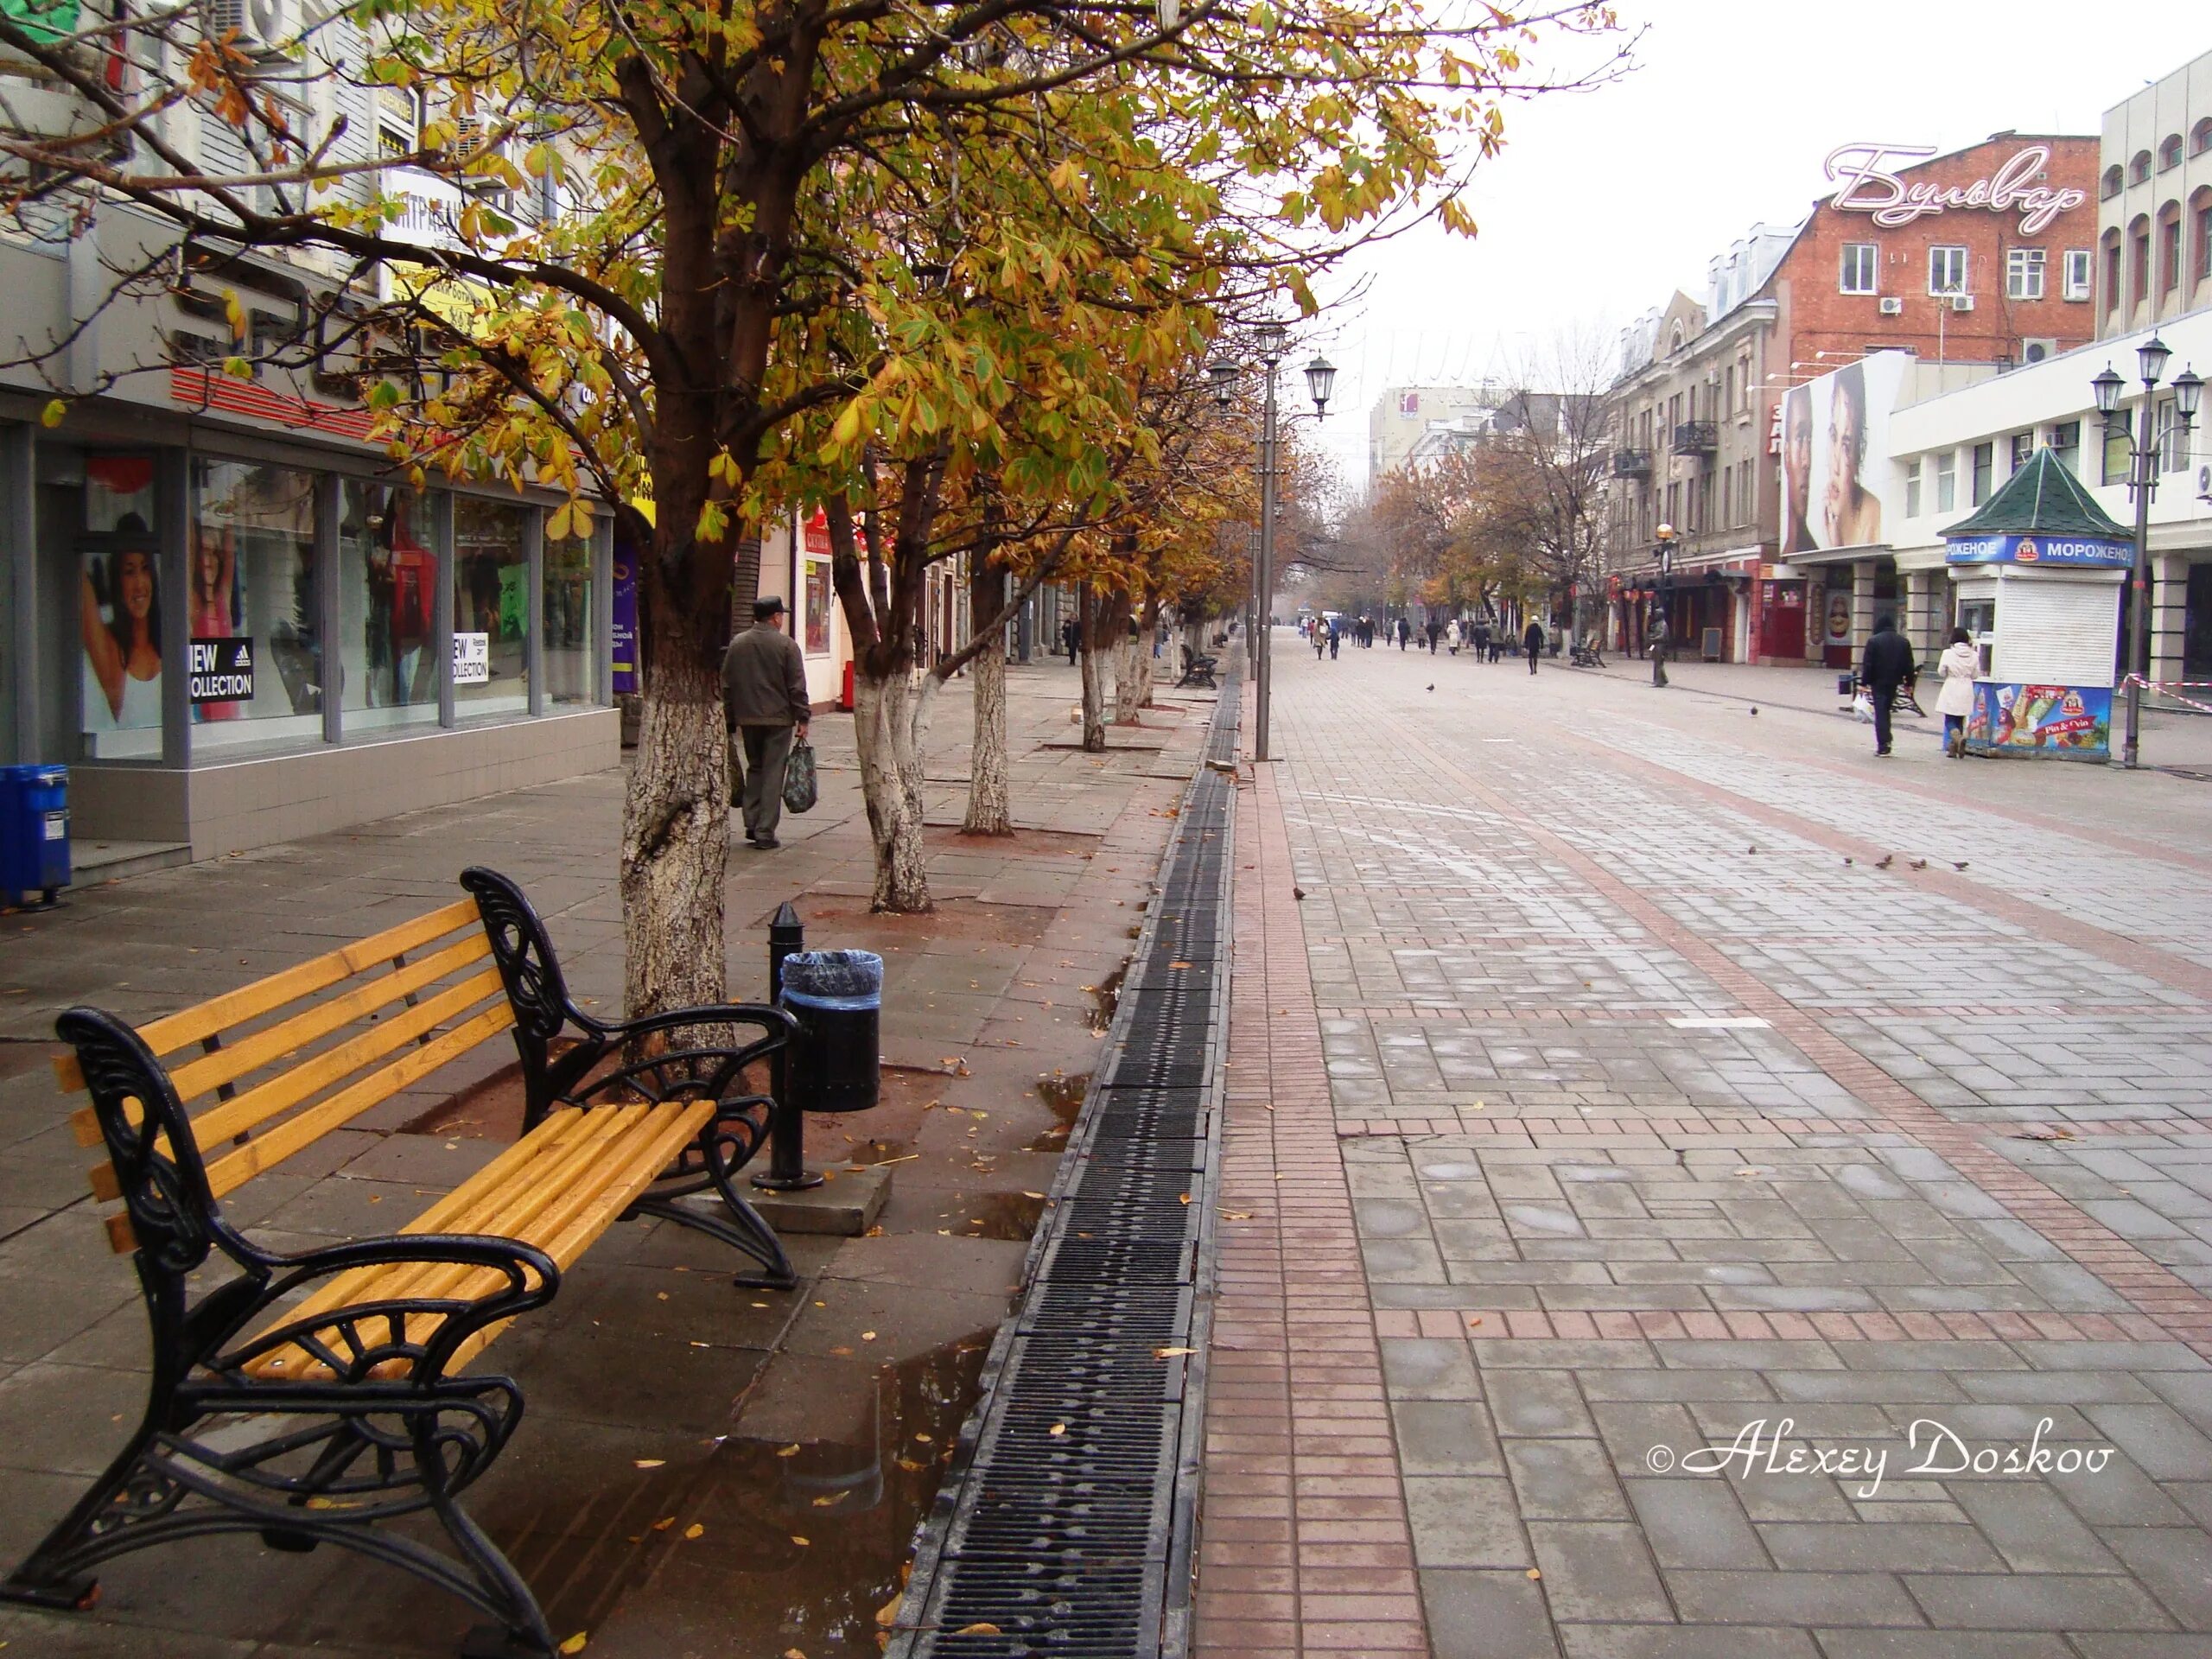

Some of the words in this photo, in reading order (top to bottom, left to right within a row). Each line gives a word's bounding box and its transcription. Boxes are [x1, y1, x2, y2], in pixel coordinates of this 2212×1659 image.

[1824, 142, 2085, 237] Бульвар
[1946, 542, 1998, 556] РОЖЕНОЕ
[454, 639, 467, 658] EW
[454, 662, 486, 677] OLLECTION
[191, 674, 251, 697] OLLECTION
[2060, 721, 2069, 731] &
